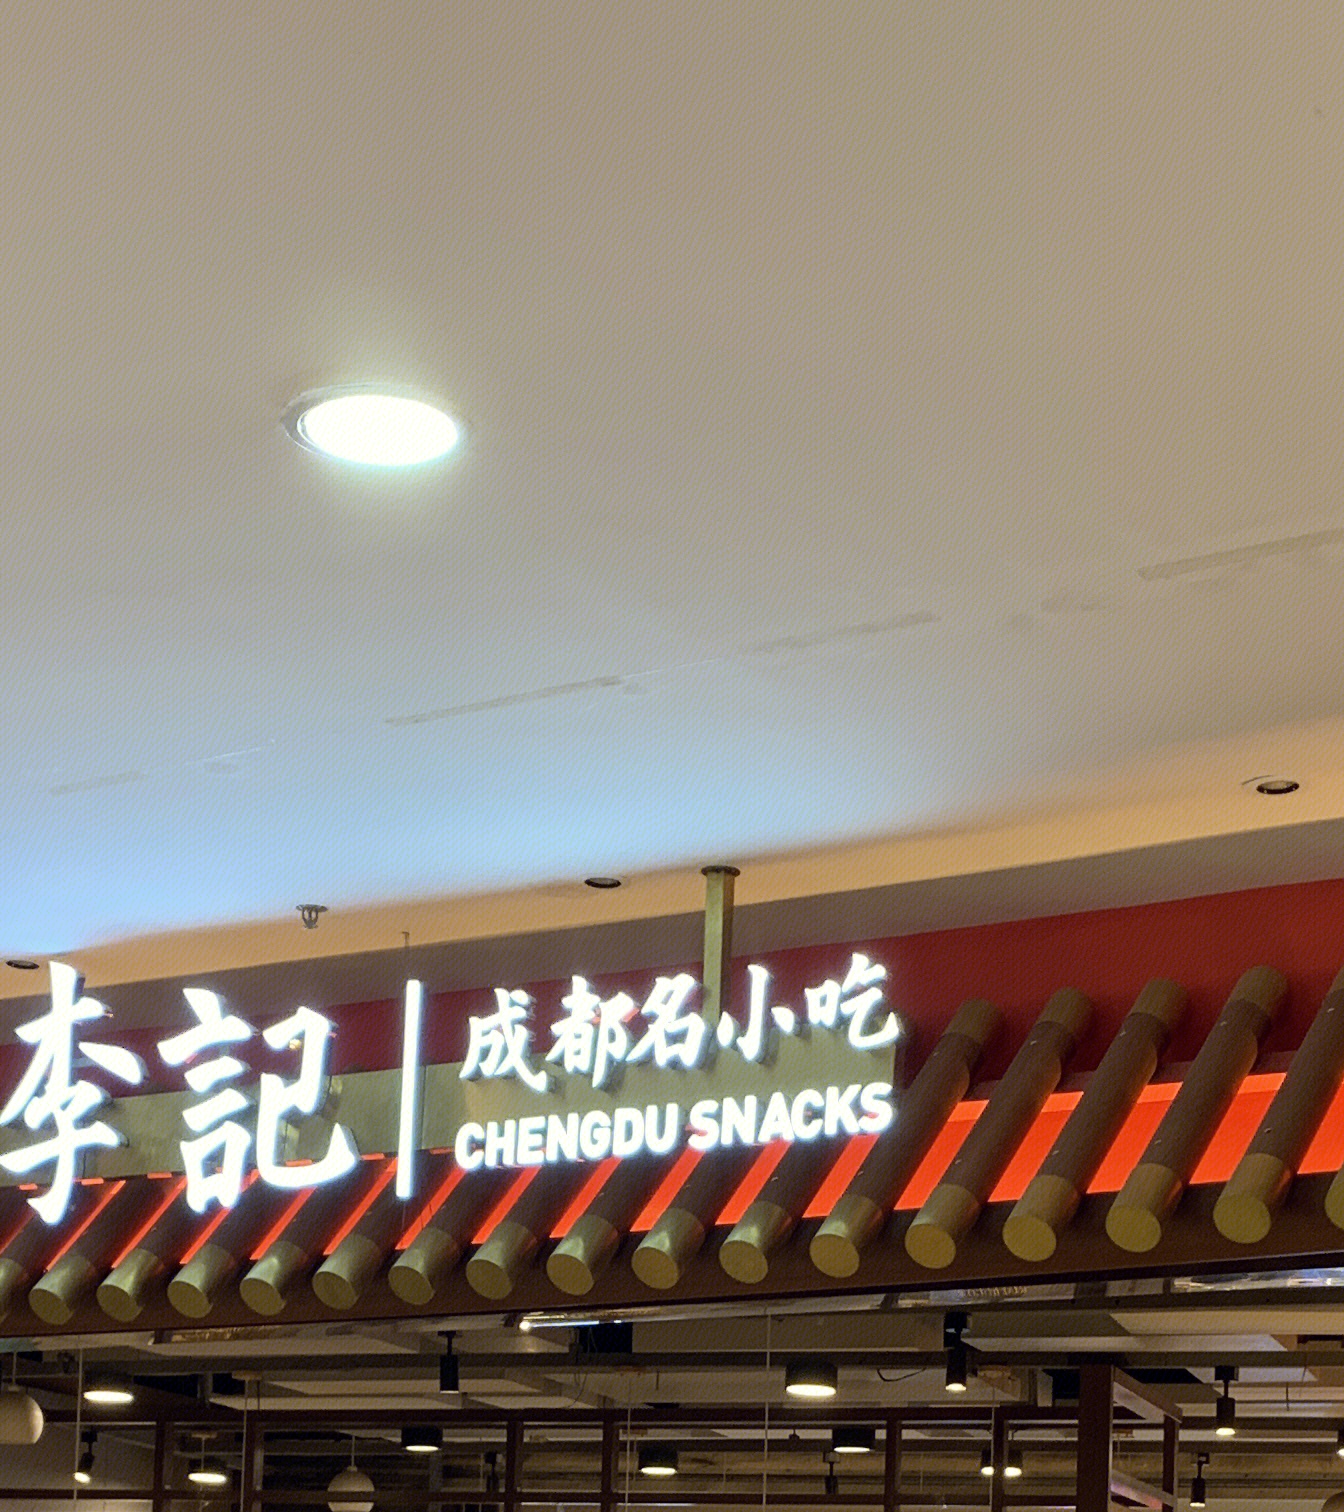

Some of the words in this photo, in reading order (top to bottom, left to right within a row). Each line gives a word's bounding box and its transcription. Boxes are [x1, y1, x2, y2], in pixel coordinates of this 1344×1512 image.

[459, 953, 901, 1093] 成都名小吃
[455, 1102, 679, 1172] CHENGDU
[686, 1081, 894, 1149] SNACKS
